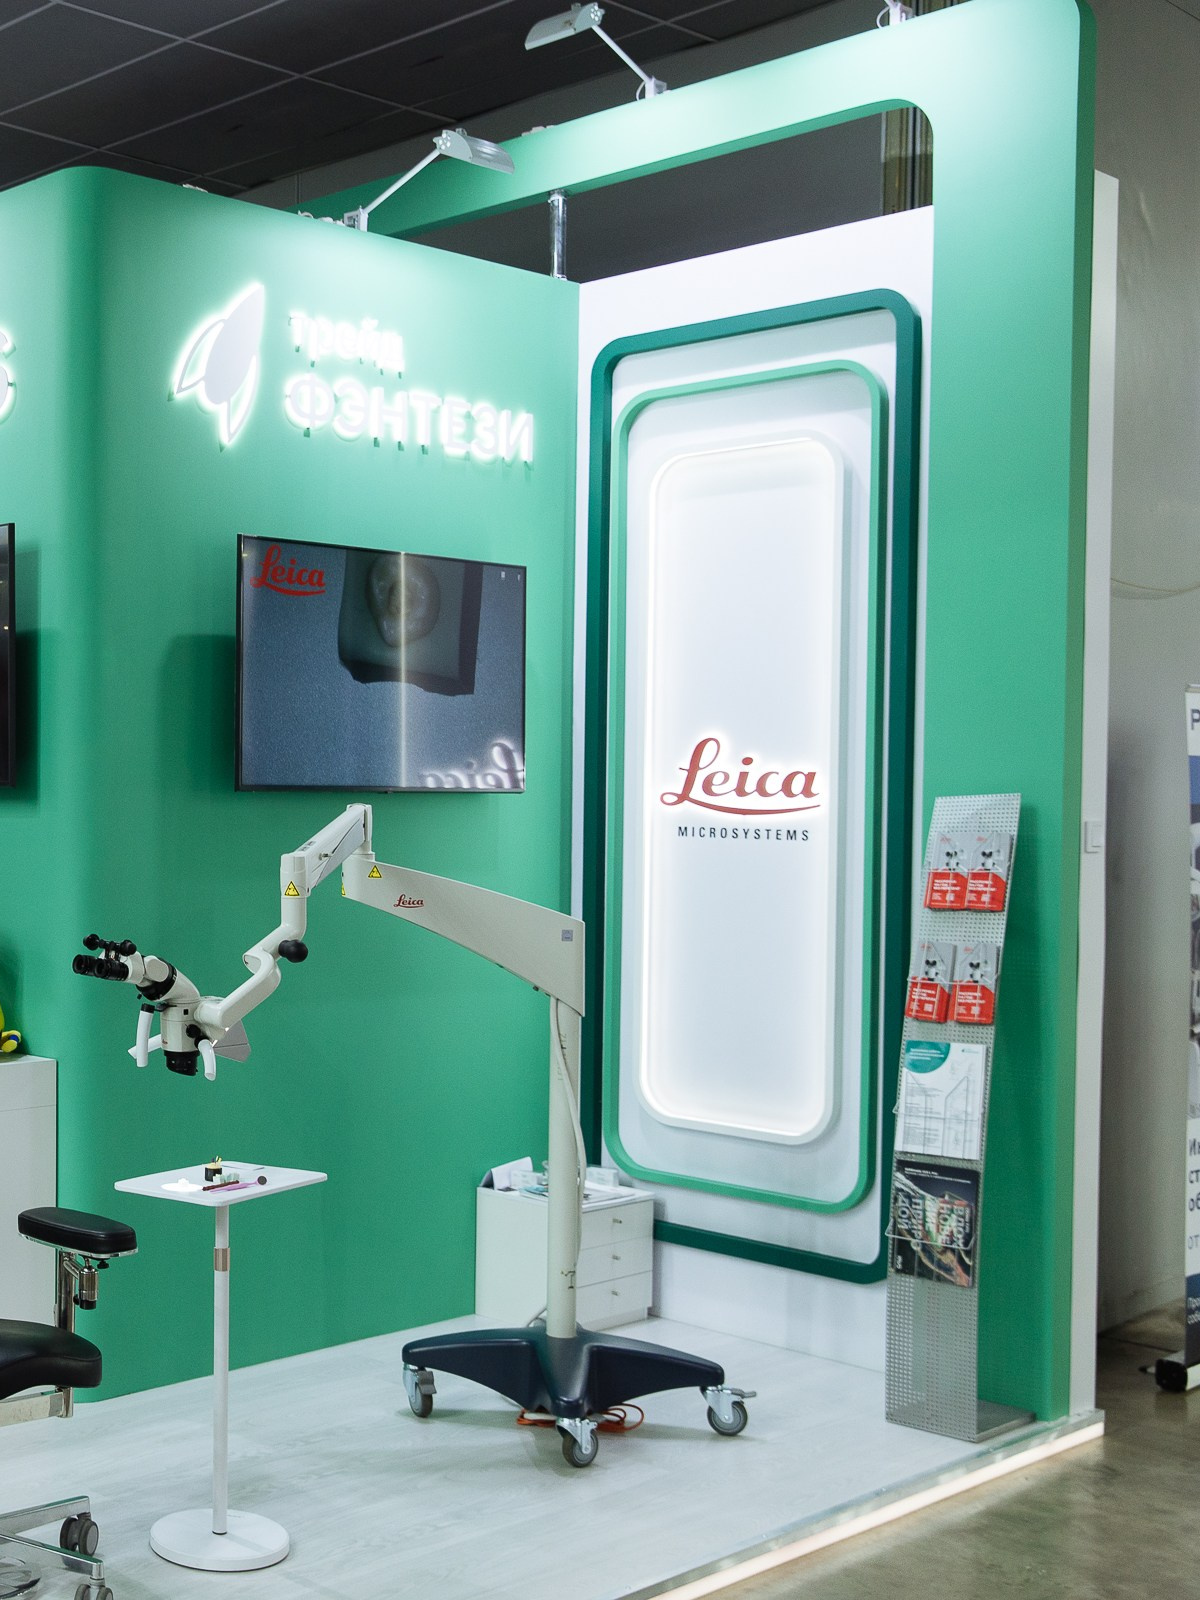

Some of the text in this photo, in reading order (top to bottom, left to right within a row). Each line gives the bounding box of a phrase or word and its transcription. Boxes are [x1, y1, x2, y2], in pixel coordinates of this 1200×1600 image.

[284, 372, 534, 463] ФЭНТЕЗИ
[250, 544, 326, 597] Leica
[660, 737, 821, 816] Leica
[677, 826, 810, 842] MICROSYSTEMS
[393, 893, 425, 909] Leica
